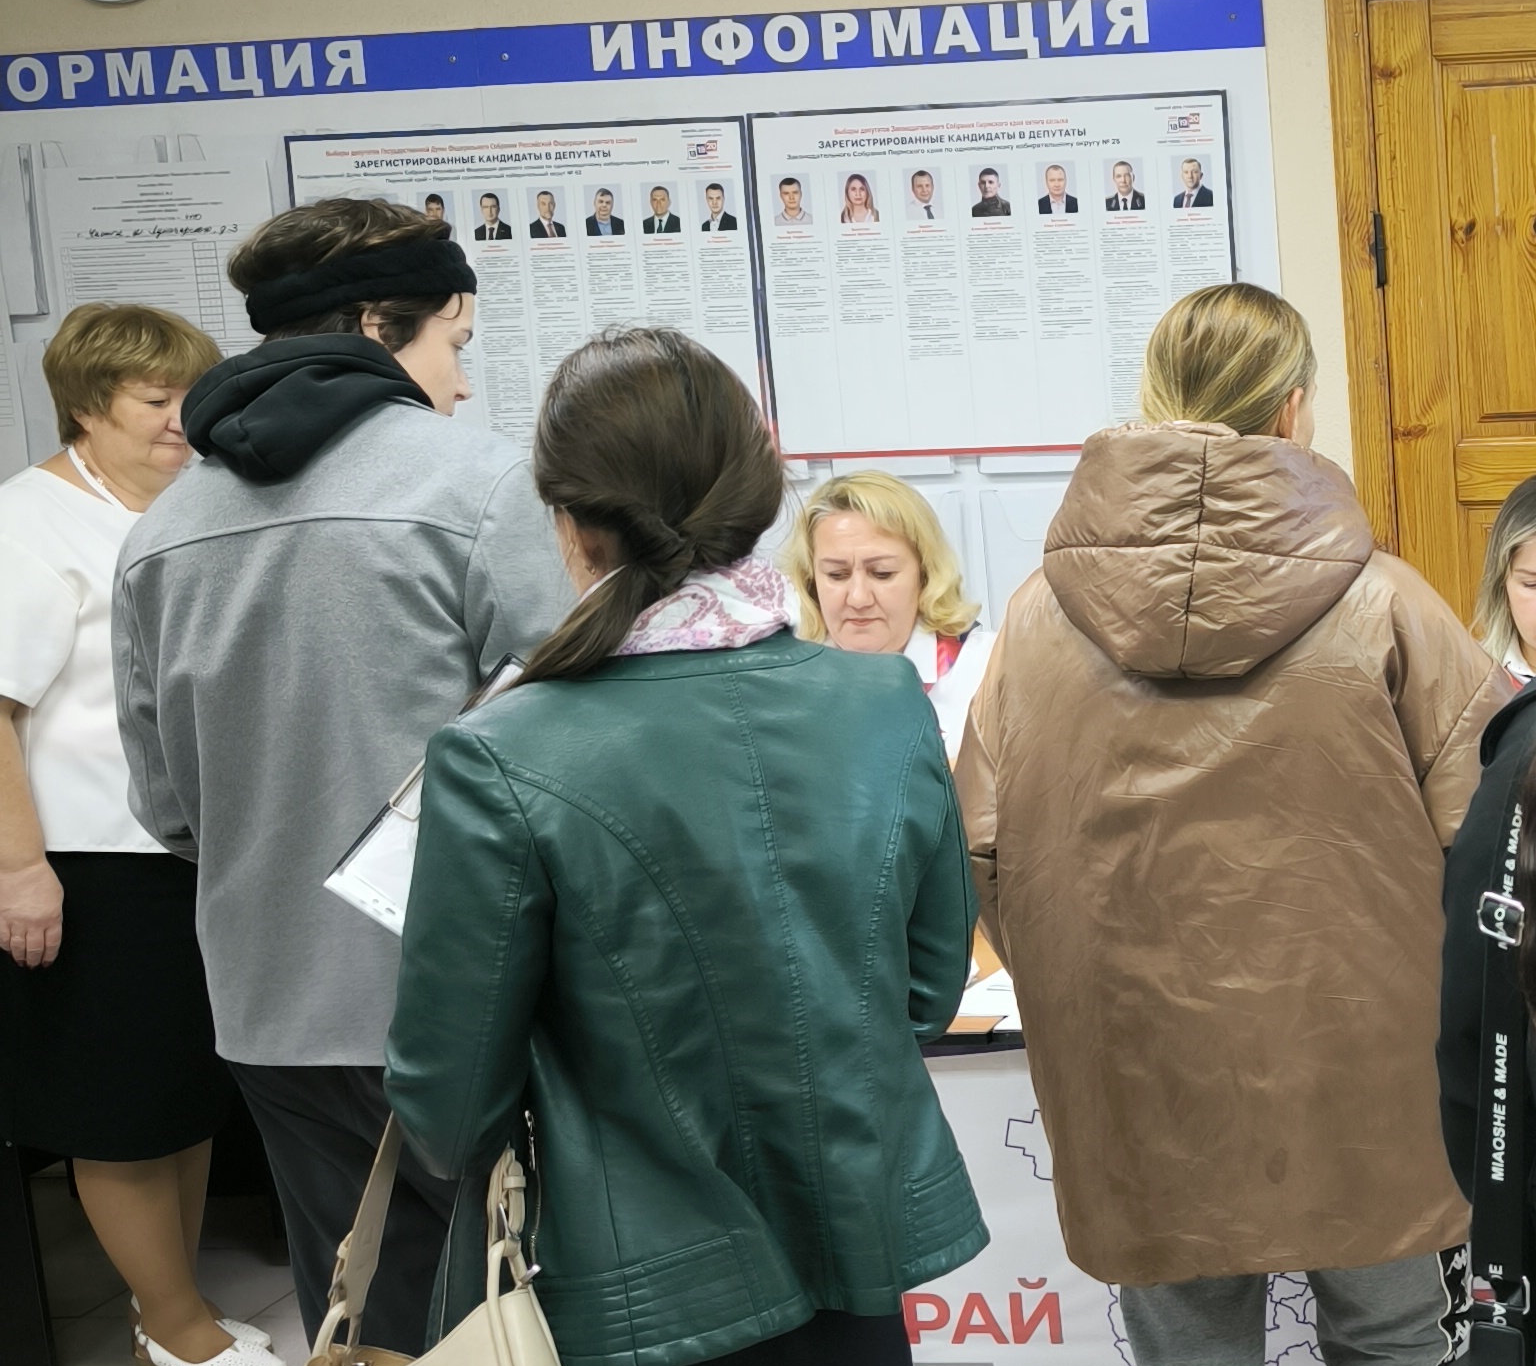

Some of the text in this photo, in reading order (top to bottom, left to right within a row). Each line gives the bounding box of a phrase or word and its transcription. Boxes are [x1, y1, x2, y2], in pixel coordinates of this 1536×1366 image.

[6, 39, 366, 103] ОРМАЦИЯ
[818, 134, 945, 149] ЗАРЕГИСТРИРОВАННЫЕ
[947, 131, 1016, 143] КАНДИДАТЫ
[1018, 130, 1027, 144] В
[1028, 128, 1086, 140] ДЕПУТАТЫ
[887, 148, 925, 156] Пермского
[1075, 139, 1103, 147] округу
[354, 155, 476, 169] ЗАРЕГИСТРИРОВАННЫЕ
[478, 152, 542, 163] КАНДИДАТЫ
[545, 151, 552, 160] В
[554, 149, 611, 161] ДЕПУТАТЫ
[1505, 858, 1516, 871] &
[1491, 1032, 1508, 1182] MIAOSHE & MADE
[901, 1277, 1064, 1345] РАЙ
